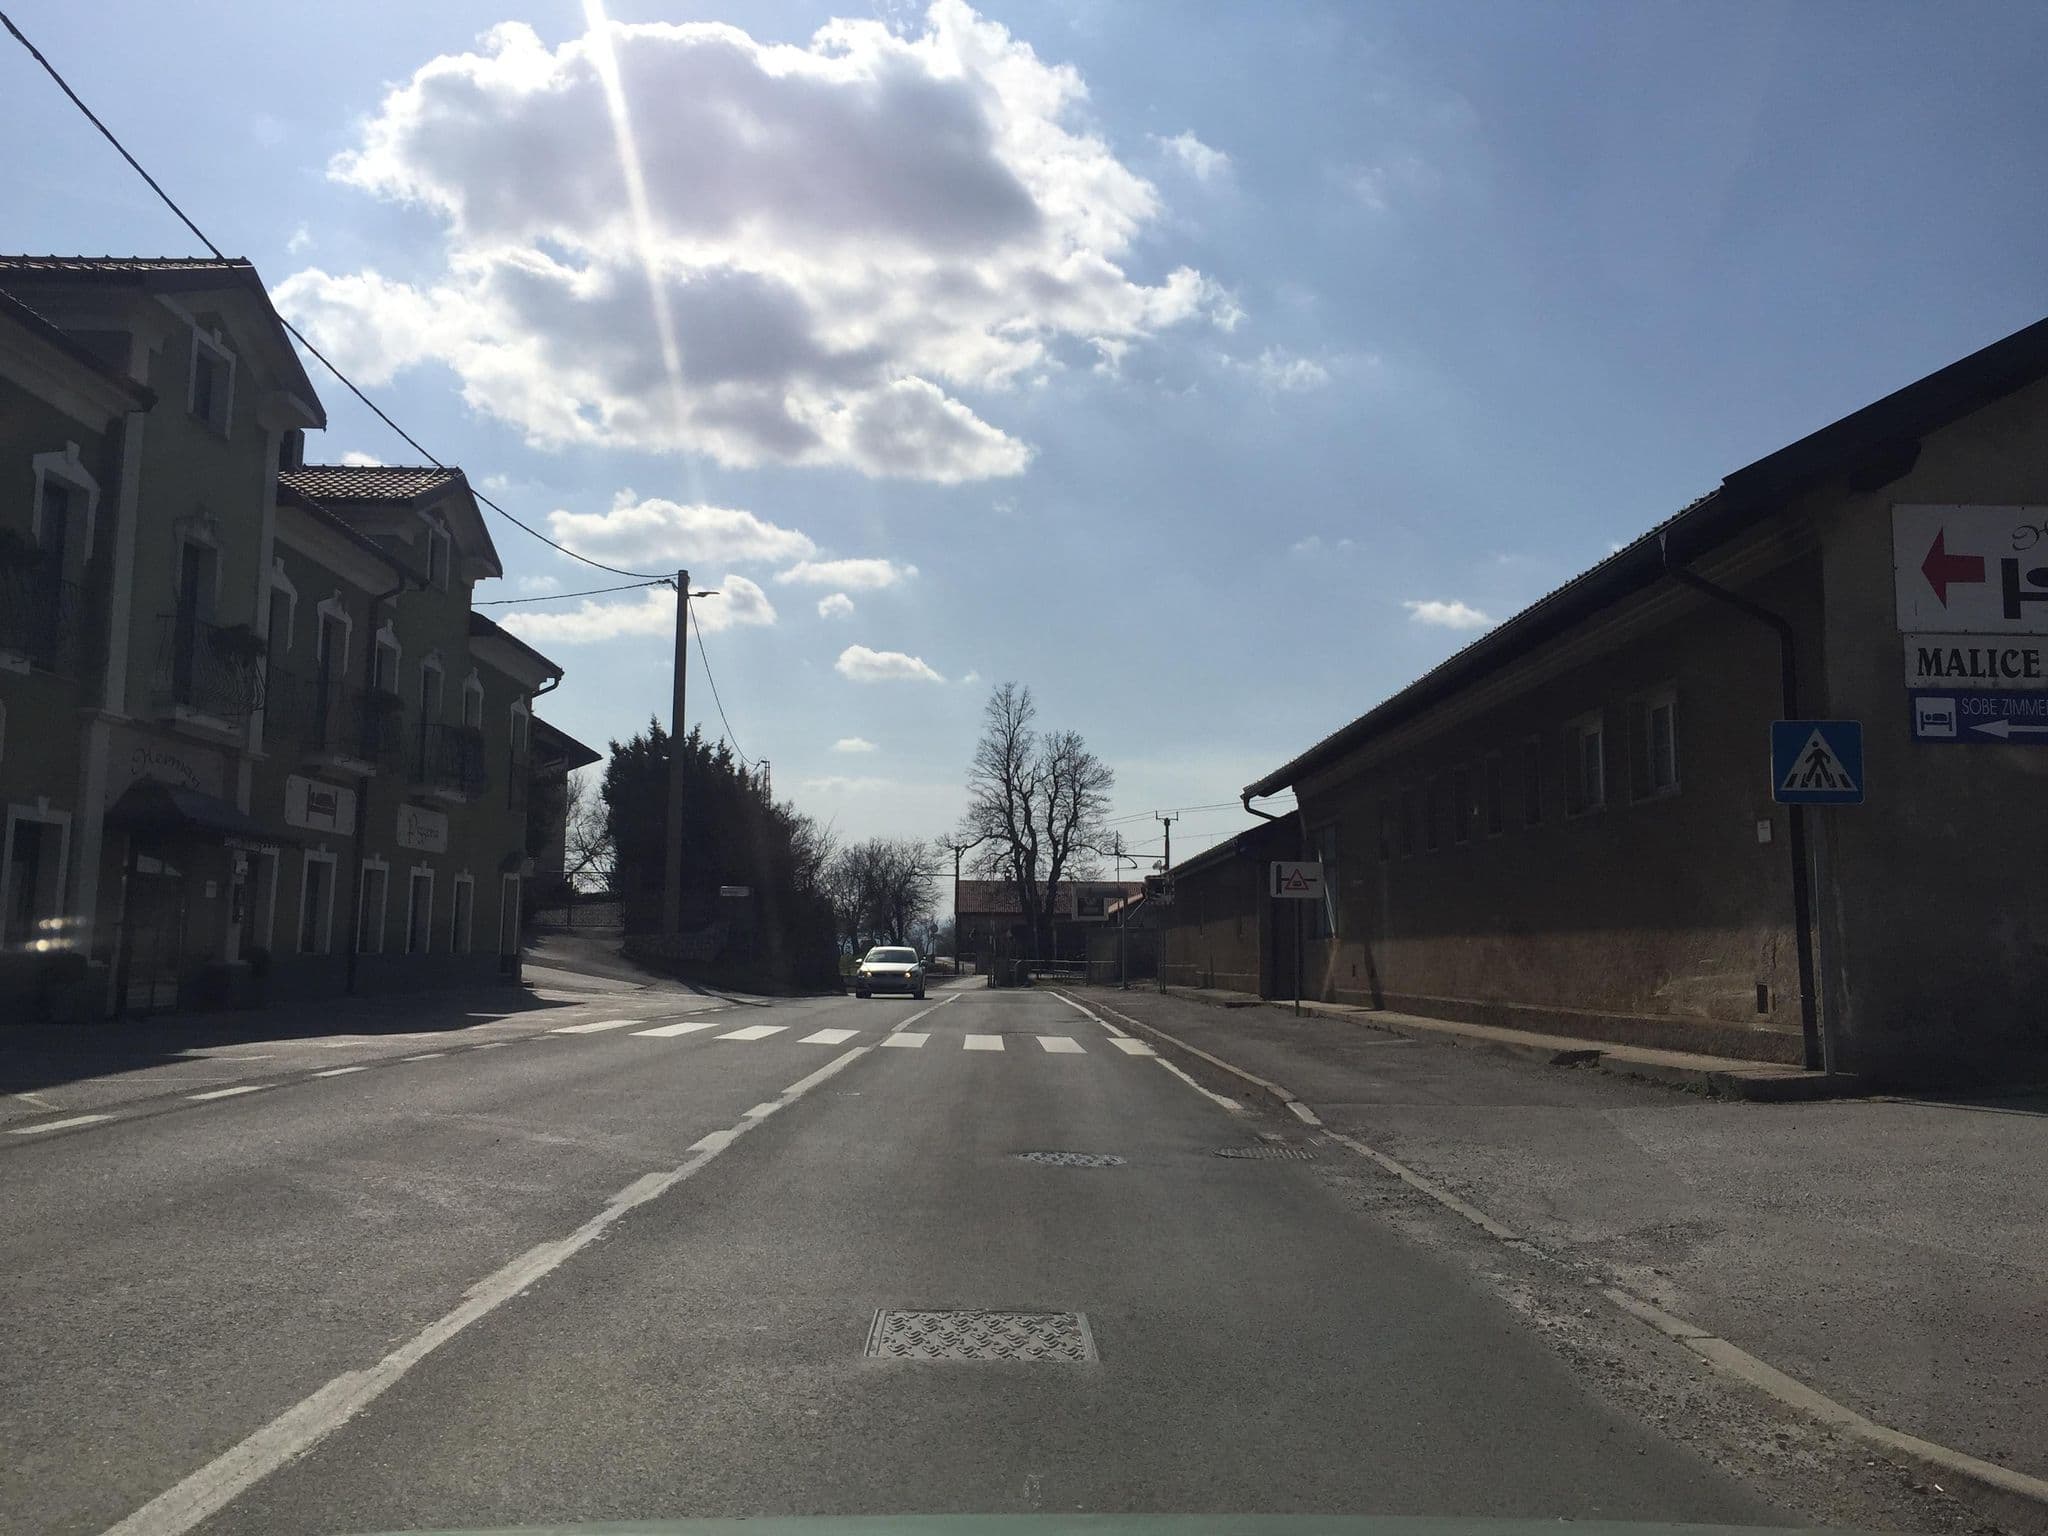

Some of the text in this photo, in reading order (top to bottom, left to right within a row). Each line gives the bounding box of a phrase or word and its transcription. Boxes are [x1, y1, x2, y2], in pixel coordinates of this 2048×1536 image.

[1917, 648, 2041, 678] MALICE
[1961, 698, 2048, 716] SOBE ZIMME
